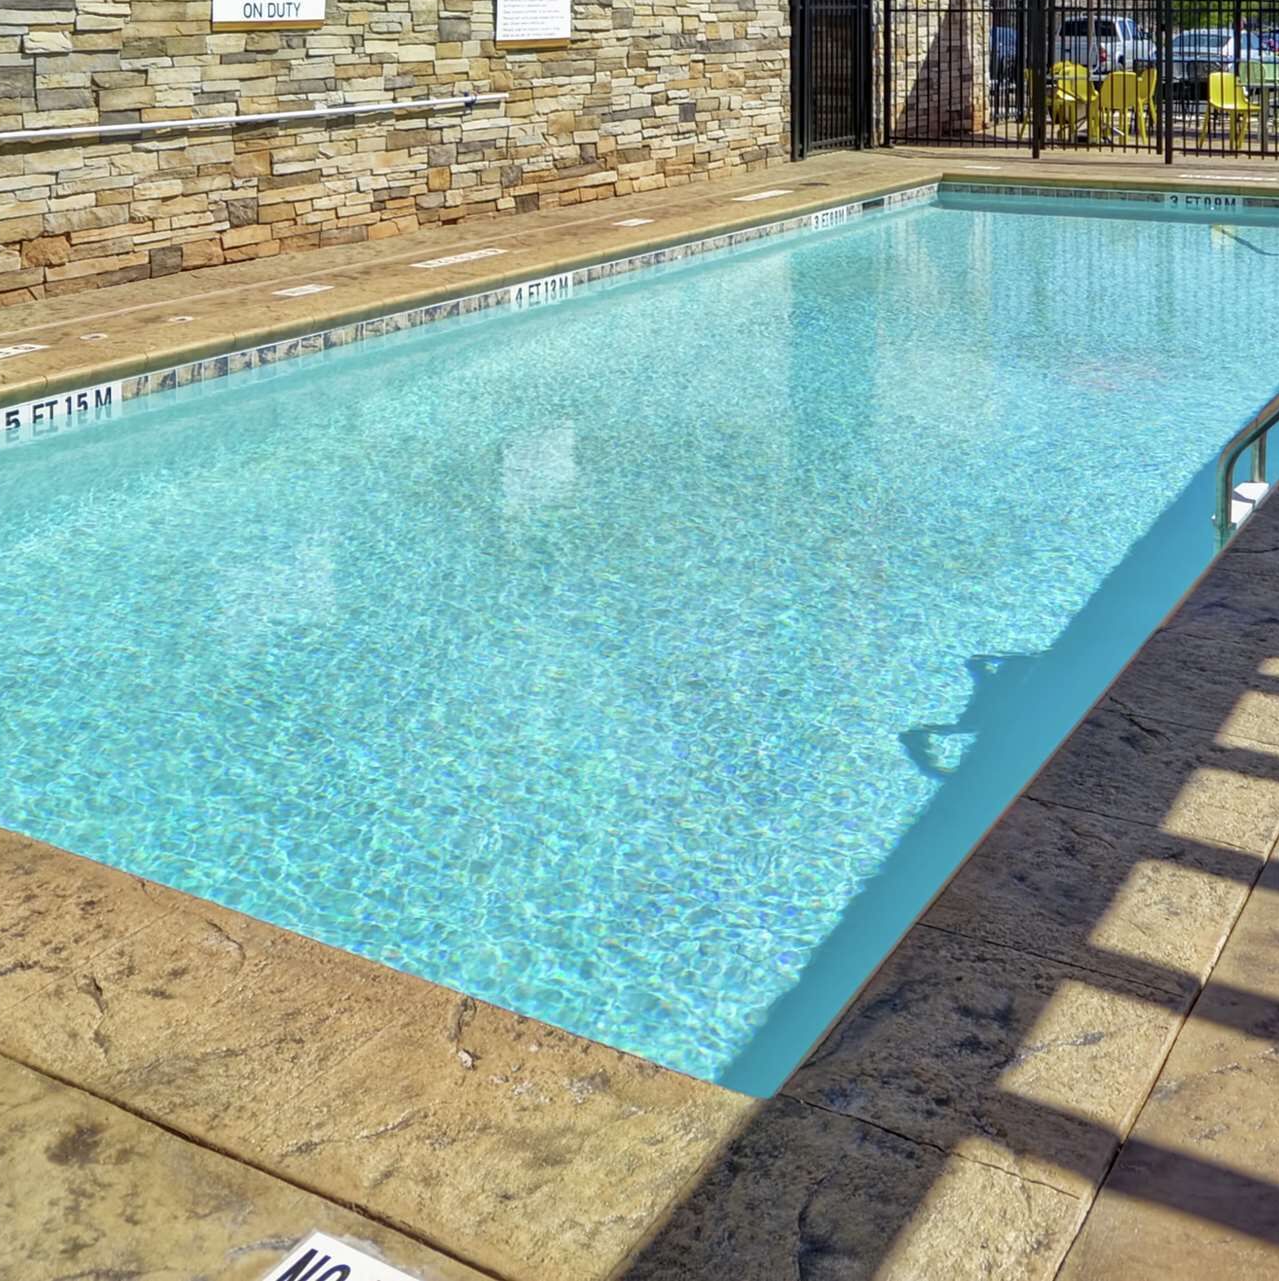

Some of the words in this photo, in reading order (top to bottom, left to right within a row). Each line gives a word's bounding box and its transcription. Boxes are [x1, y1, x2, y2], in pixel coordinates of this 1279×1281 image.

[243, 2, 262, 18] ON
[268, 2, 300, 18] DUTY
[5, 409, 20, 431] 5
[32, 400, 58, 424] FT
[95, 387, 112, 408] M
